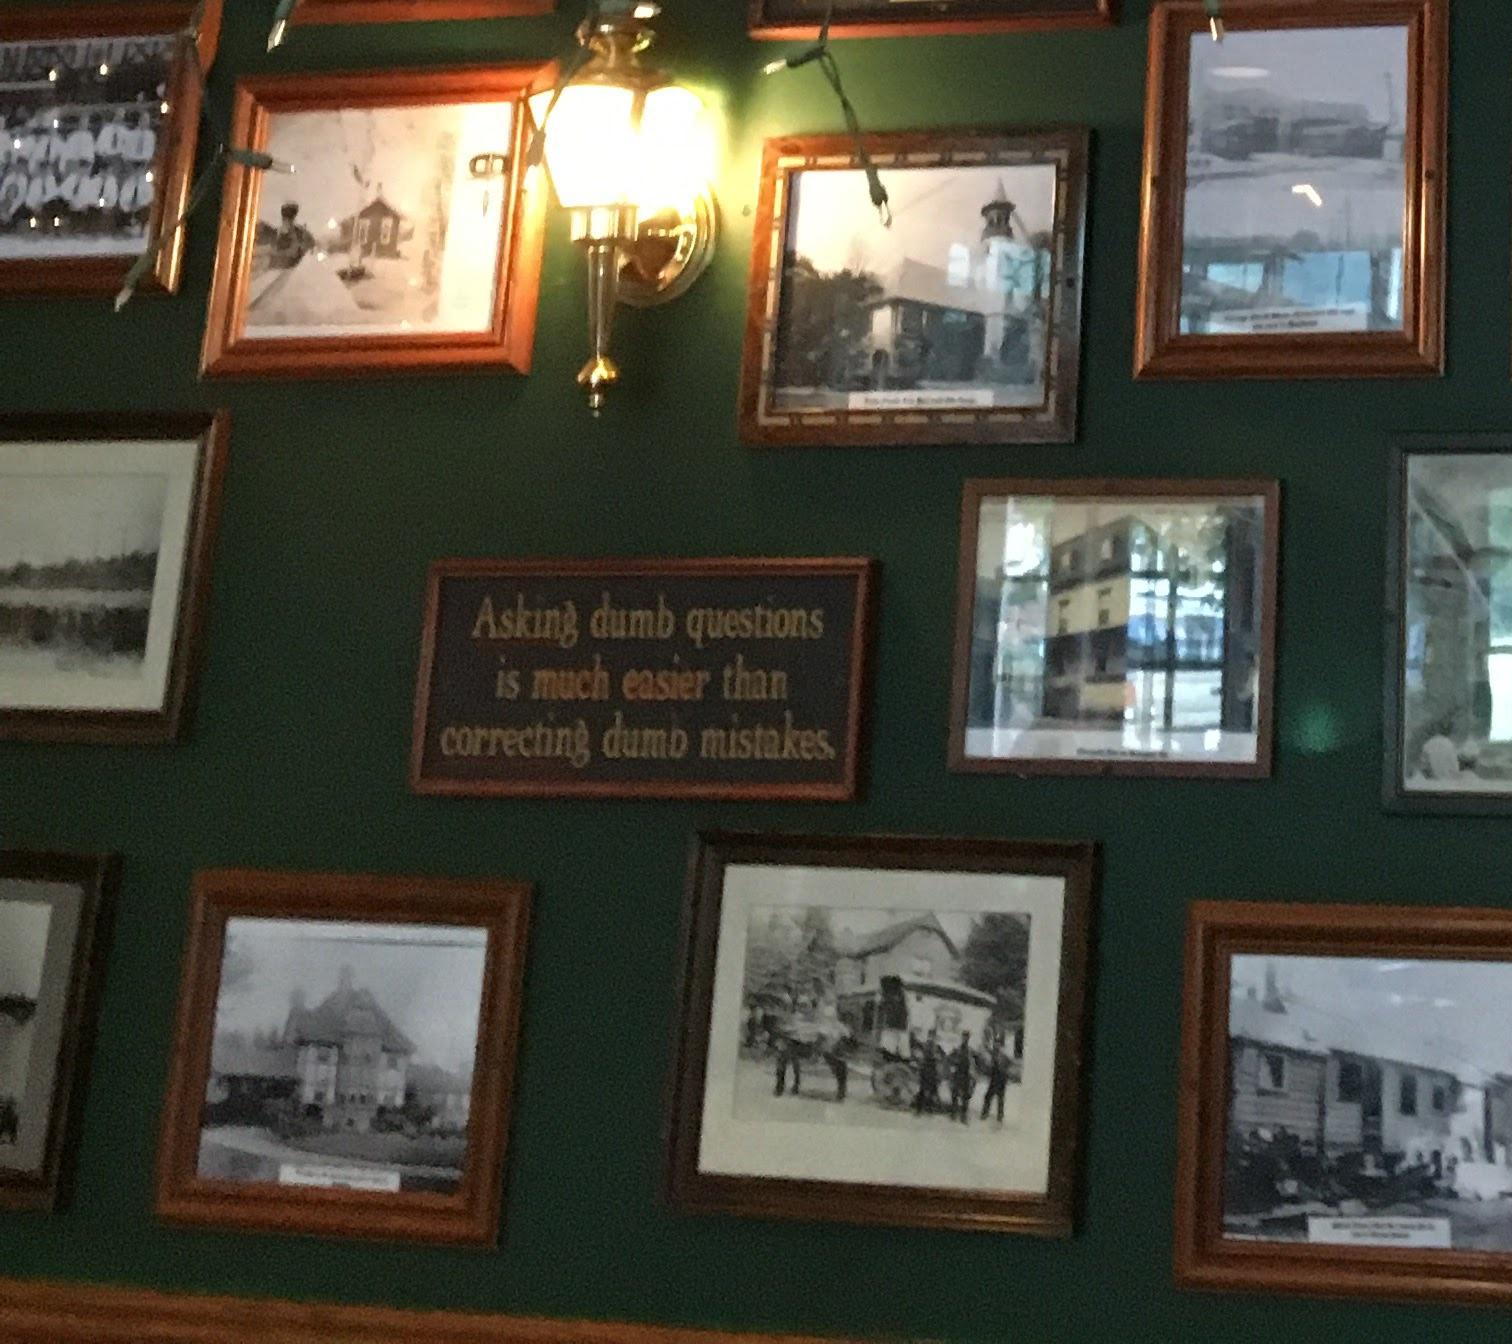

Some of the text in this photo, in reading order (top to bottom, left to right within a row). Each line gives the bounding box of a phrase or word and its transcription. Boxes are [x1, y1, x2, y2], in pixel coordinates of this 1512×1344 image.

[472, 592, 825, 649] Asking dumb questions
[496, 652, 788, 701] is much easier than
[440, 714, 592, 769] correcting
[700, 710, 836, 760] mistakes.
